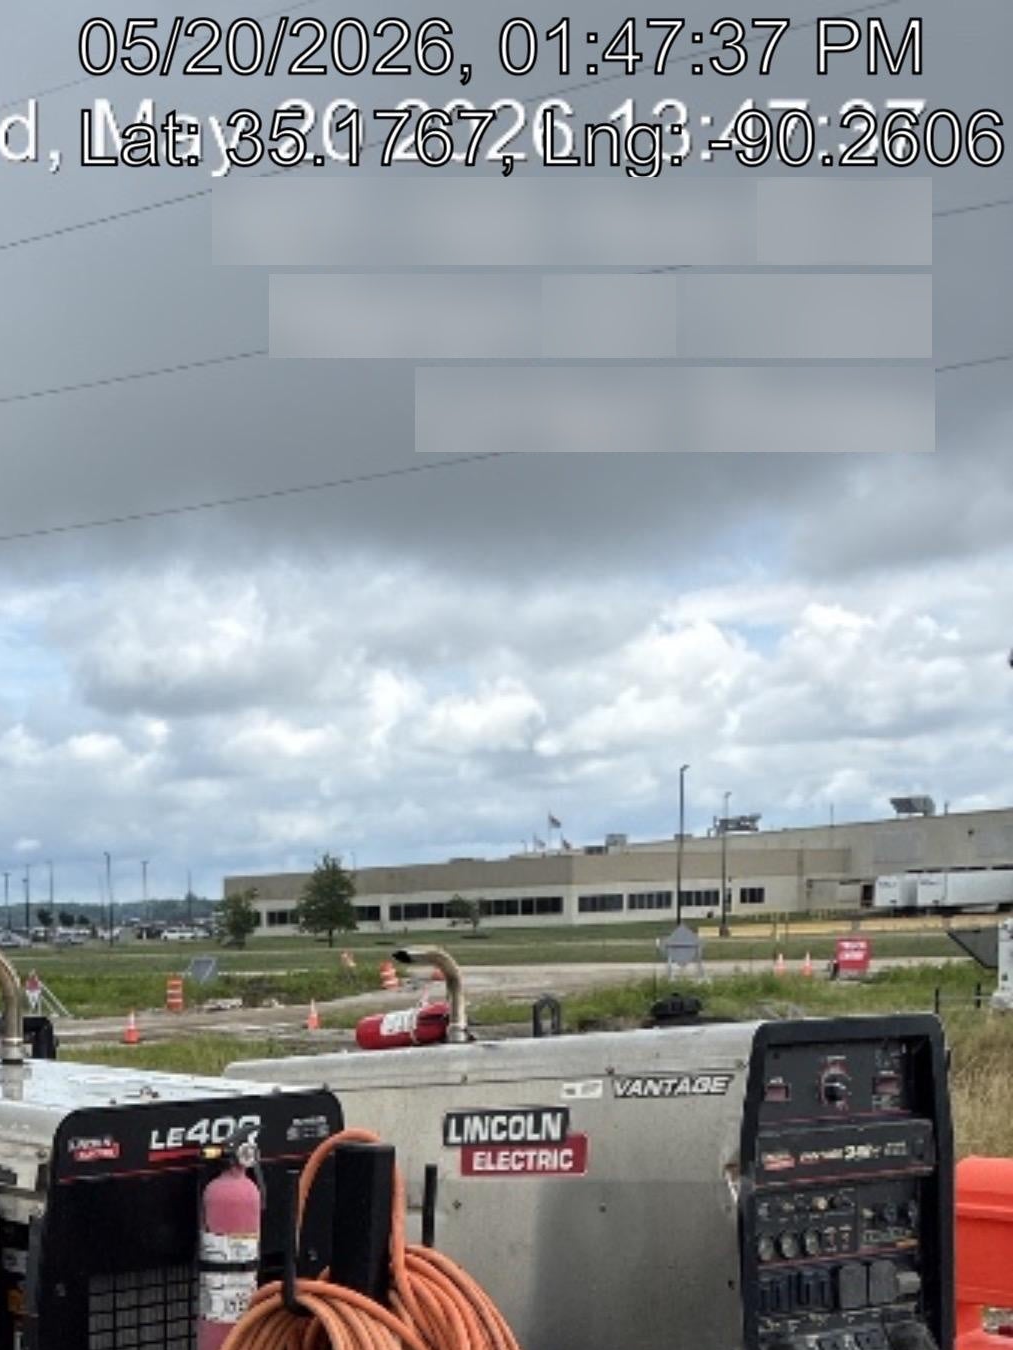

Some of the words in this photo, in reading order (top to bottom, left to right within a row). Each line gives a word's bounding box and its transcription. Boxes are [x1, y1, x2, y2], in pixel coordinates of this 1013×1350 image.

[614, 1075, 734, 1098] VANTAGE
[446, 1112, 564, 1144] LINCOLN
[472, 1148, 575, 1172] ELECTRIC
